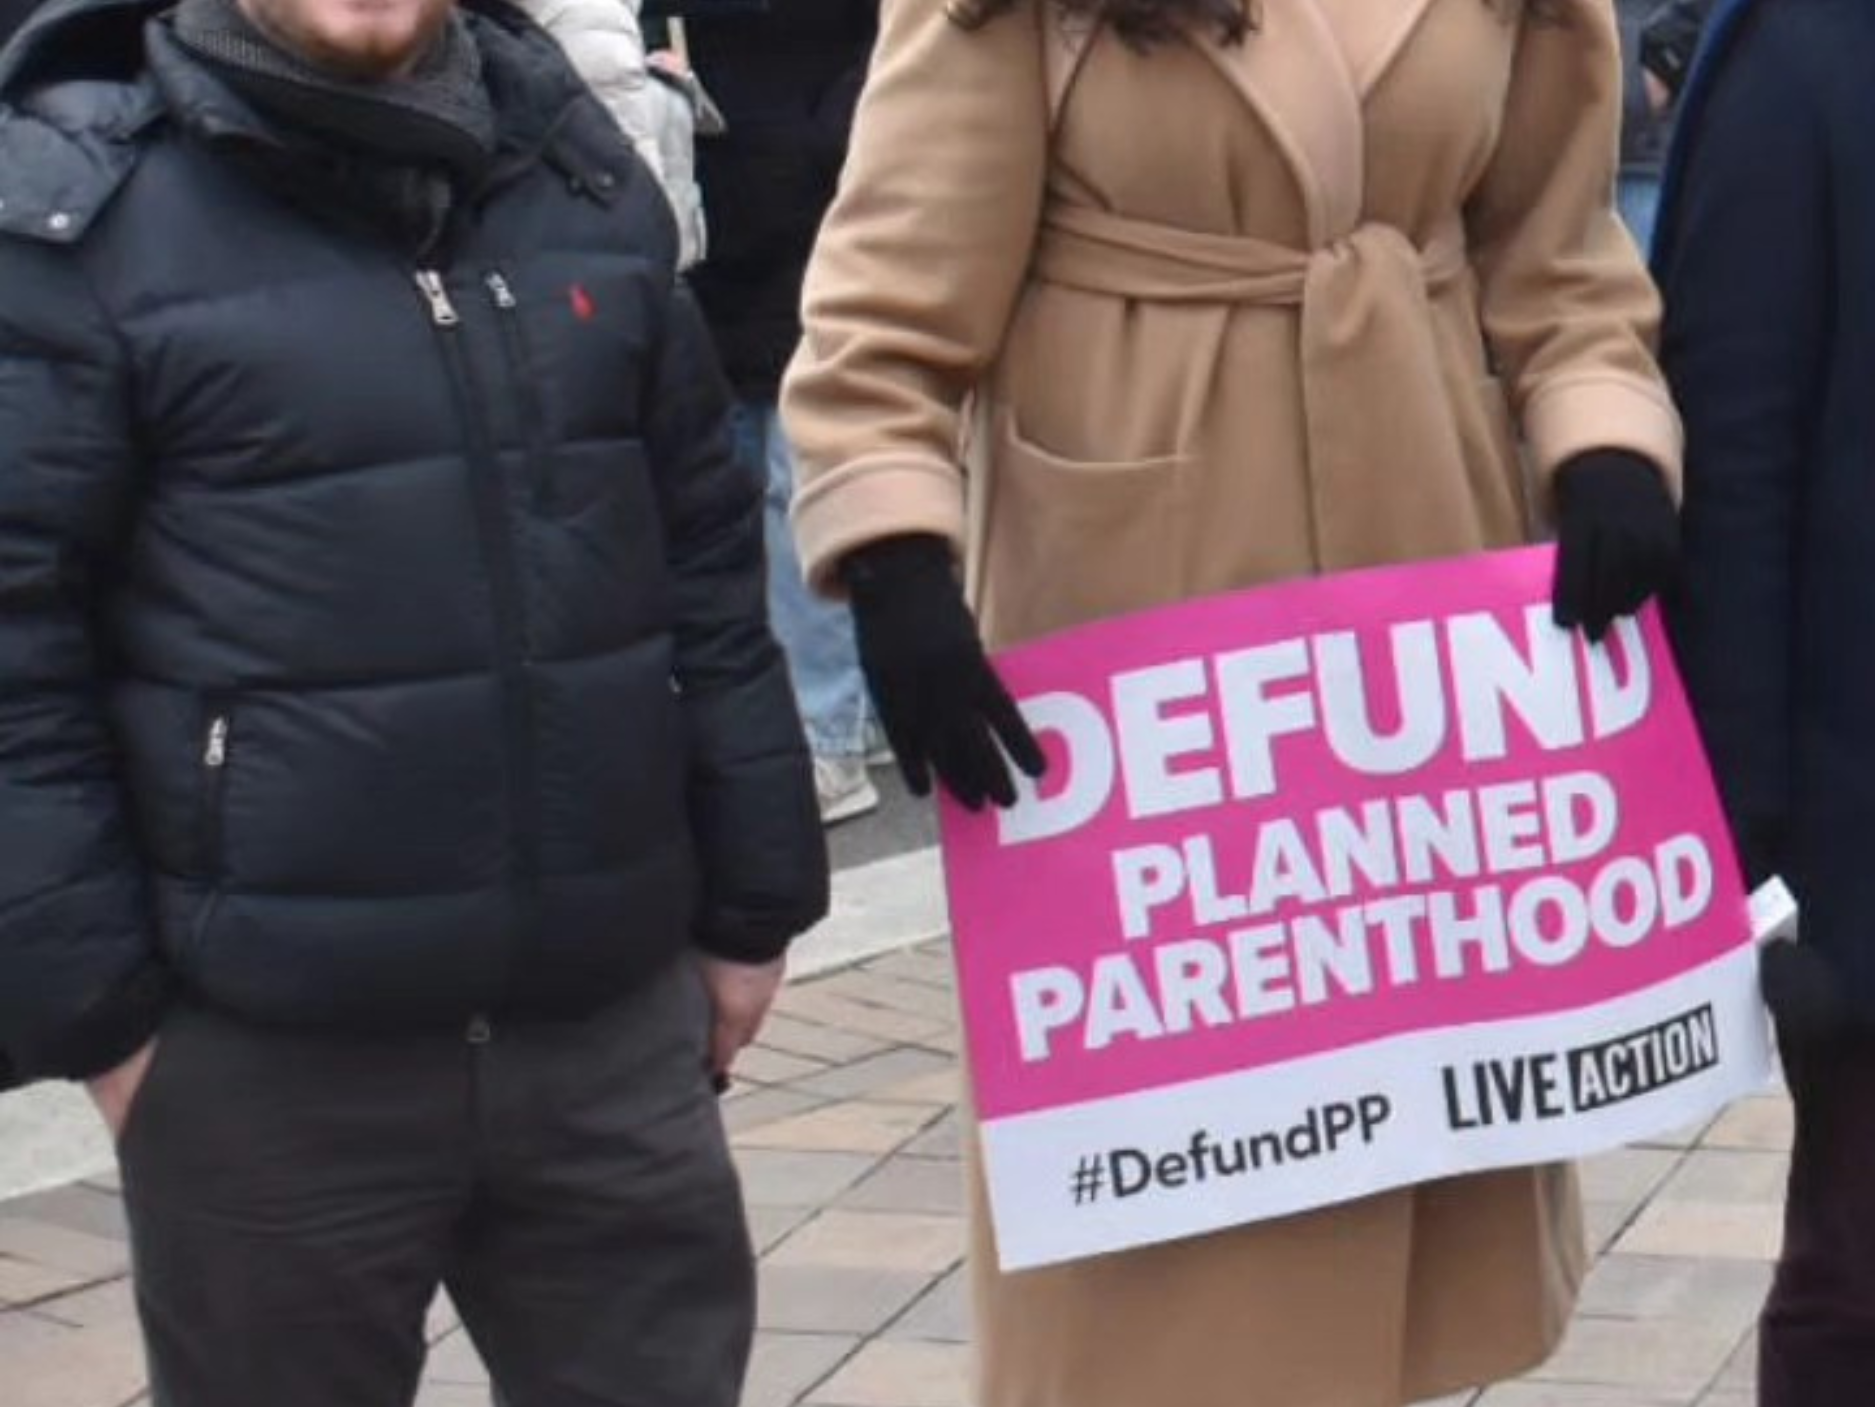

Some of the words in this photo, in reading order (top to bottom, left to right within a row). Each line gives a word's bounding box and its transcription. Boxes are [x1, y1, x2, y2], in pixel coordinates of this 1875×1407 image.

[990, 602, 1652, 846] DEFUND
[1111, 772, 1619, 940] PLANNED
[1009, 832, 1713, 1062] PARENTHOOD
[1072, 1092, 1391, 1206] #DefundPP
[1441, 1052, 1566, 1131] LIVE
[1574, 1006, 1717, 1109] ACTION
